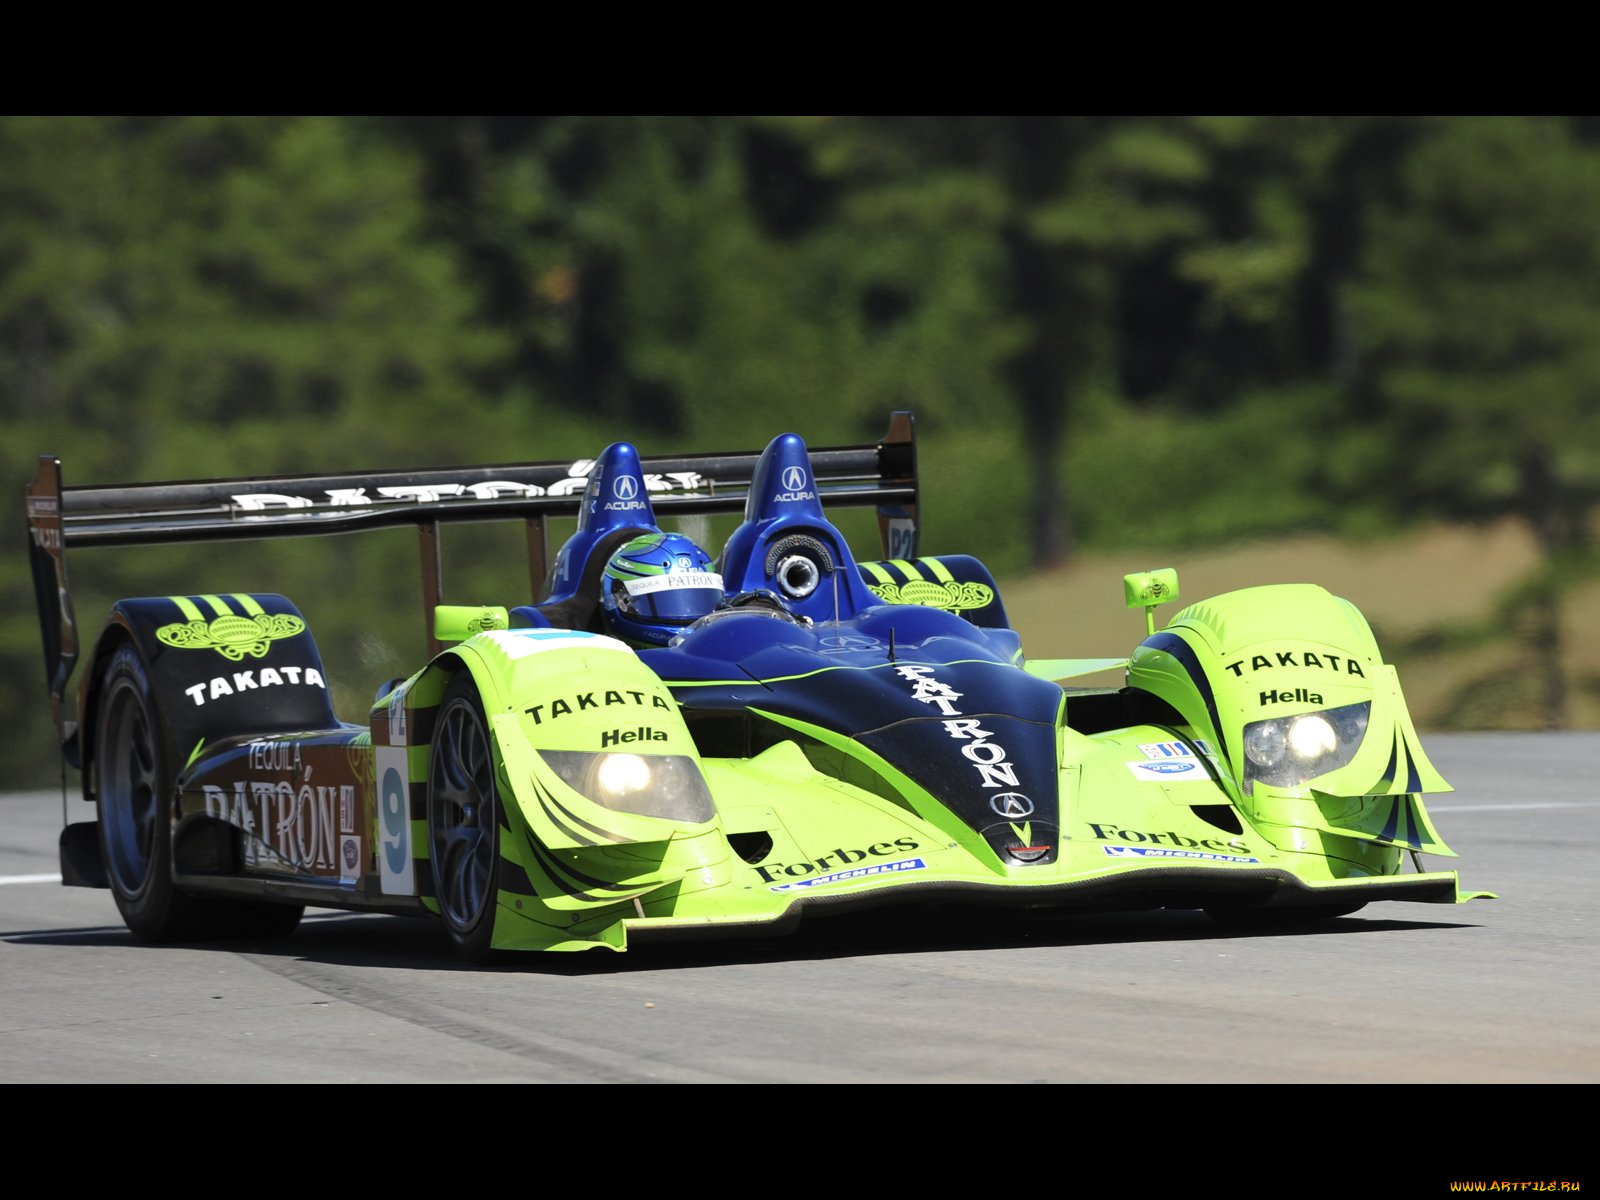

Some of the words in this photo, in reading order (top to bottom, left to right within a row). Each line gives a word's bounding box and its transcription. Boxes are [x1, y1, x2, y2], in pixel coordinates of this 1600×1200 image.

[604, 501, 647, 511] ACURA
[774, 492, 815, 502] ACURA
[1225, 652, 1365, 679] TAKATA
[184, 666, 326, 706] TAKATA
[1259, 688, 1324, 706] Hella
[524, 690, 671, 725] TAKATA
[601, 727, 668, 748] Hella
[249, 741, 302, 771] TEQUILA
[382, 767, 408, 875] 9
[1087, 823, 1252, 854] Forbes
[752, 836, 920, 884] Forbes
[1145, 849, 1251, 863] MICHELIN
[810, 859, 917, 886] MICHELIN
